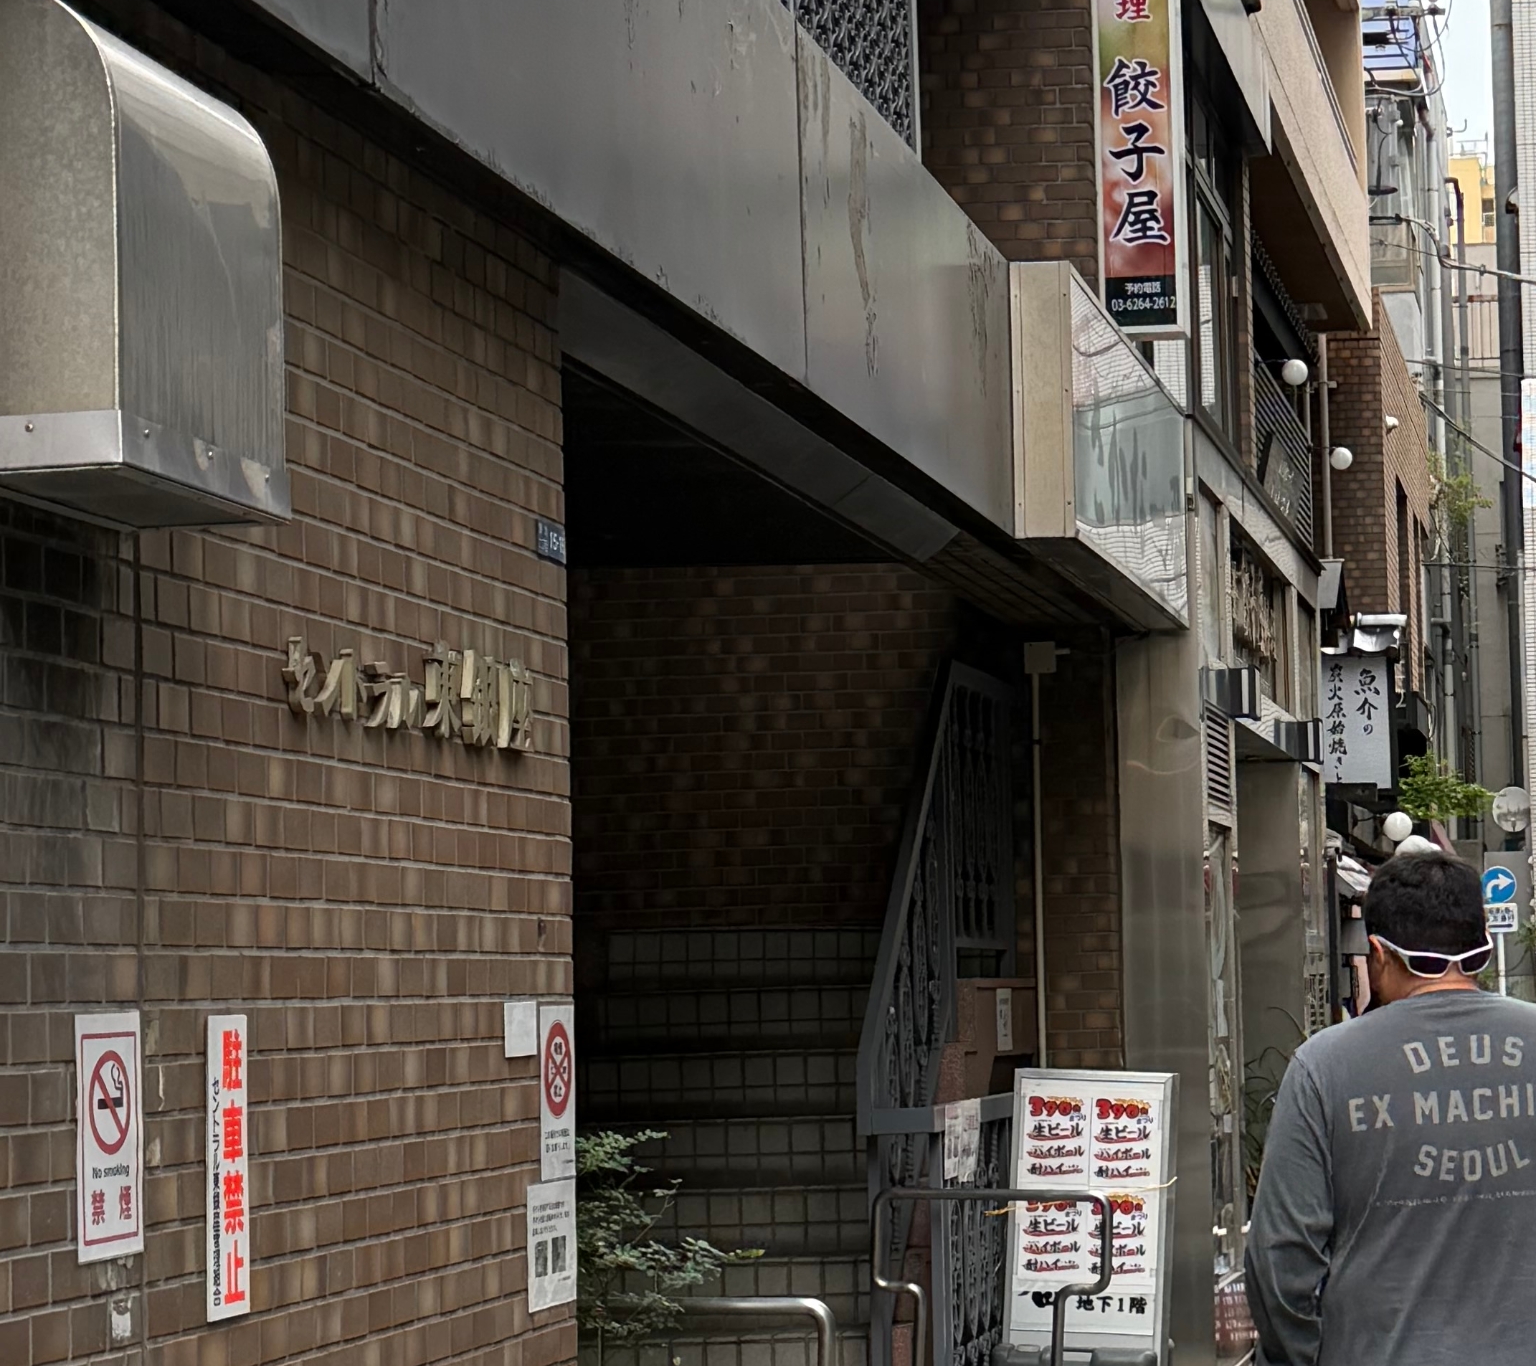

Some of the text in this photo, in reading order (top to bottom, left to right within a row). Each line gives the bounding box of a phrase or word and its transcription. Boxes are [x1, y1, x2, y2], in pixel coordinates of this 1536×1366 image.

[1106, 58, 1169, 244] 餃子屋
[1125, 282, 1161, 295] 予約電話
[1111, 296, 1176, 311] 03-6264-2612
[1354, 668, 1381, 735] 魚介の
[1403, 1034, 1524, 1073] DEUS
[1349, 1094, 1394, 1132] EX
[1032, 1122, 1084, 1137] 生ビール
[1099, 1125, 1151, 1140] 生ビール
[92, 1163, 130, 1179] No smoking
[222, 1028, 246, 1305] 駐車禁止
[1414, 1139, 1530, 1181] SEOUL
[91, 1185, 132, 1226] 禁煙
[1028, 1218, 1080, 1233] 生ビール
[1076, 1294, 1148, 1315] 地下1階
